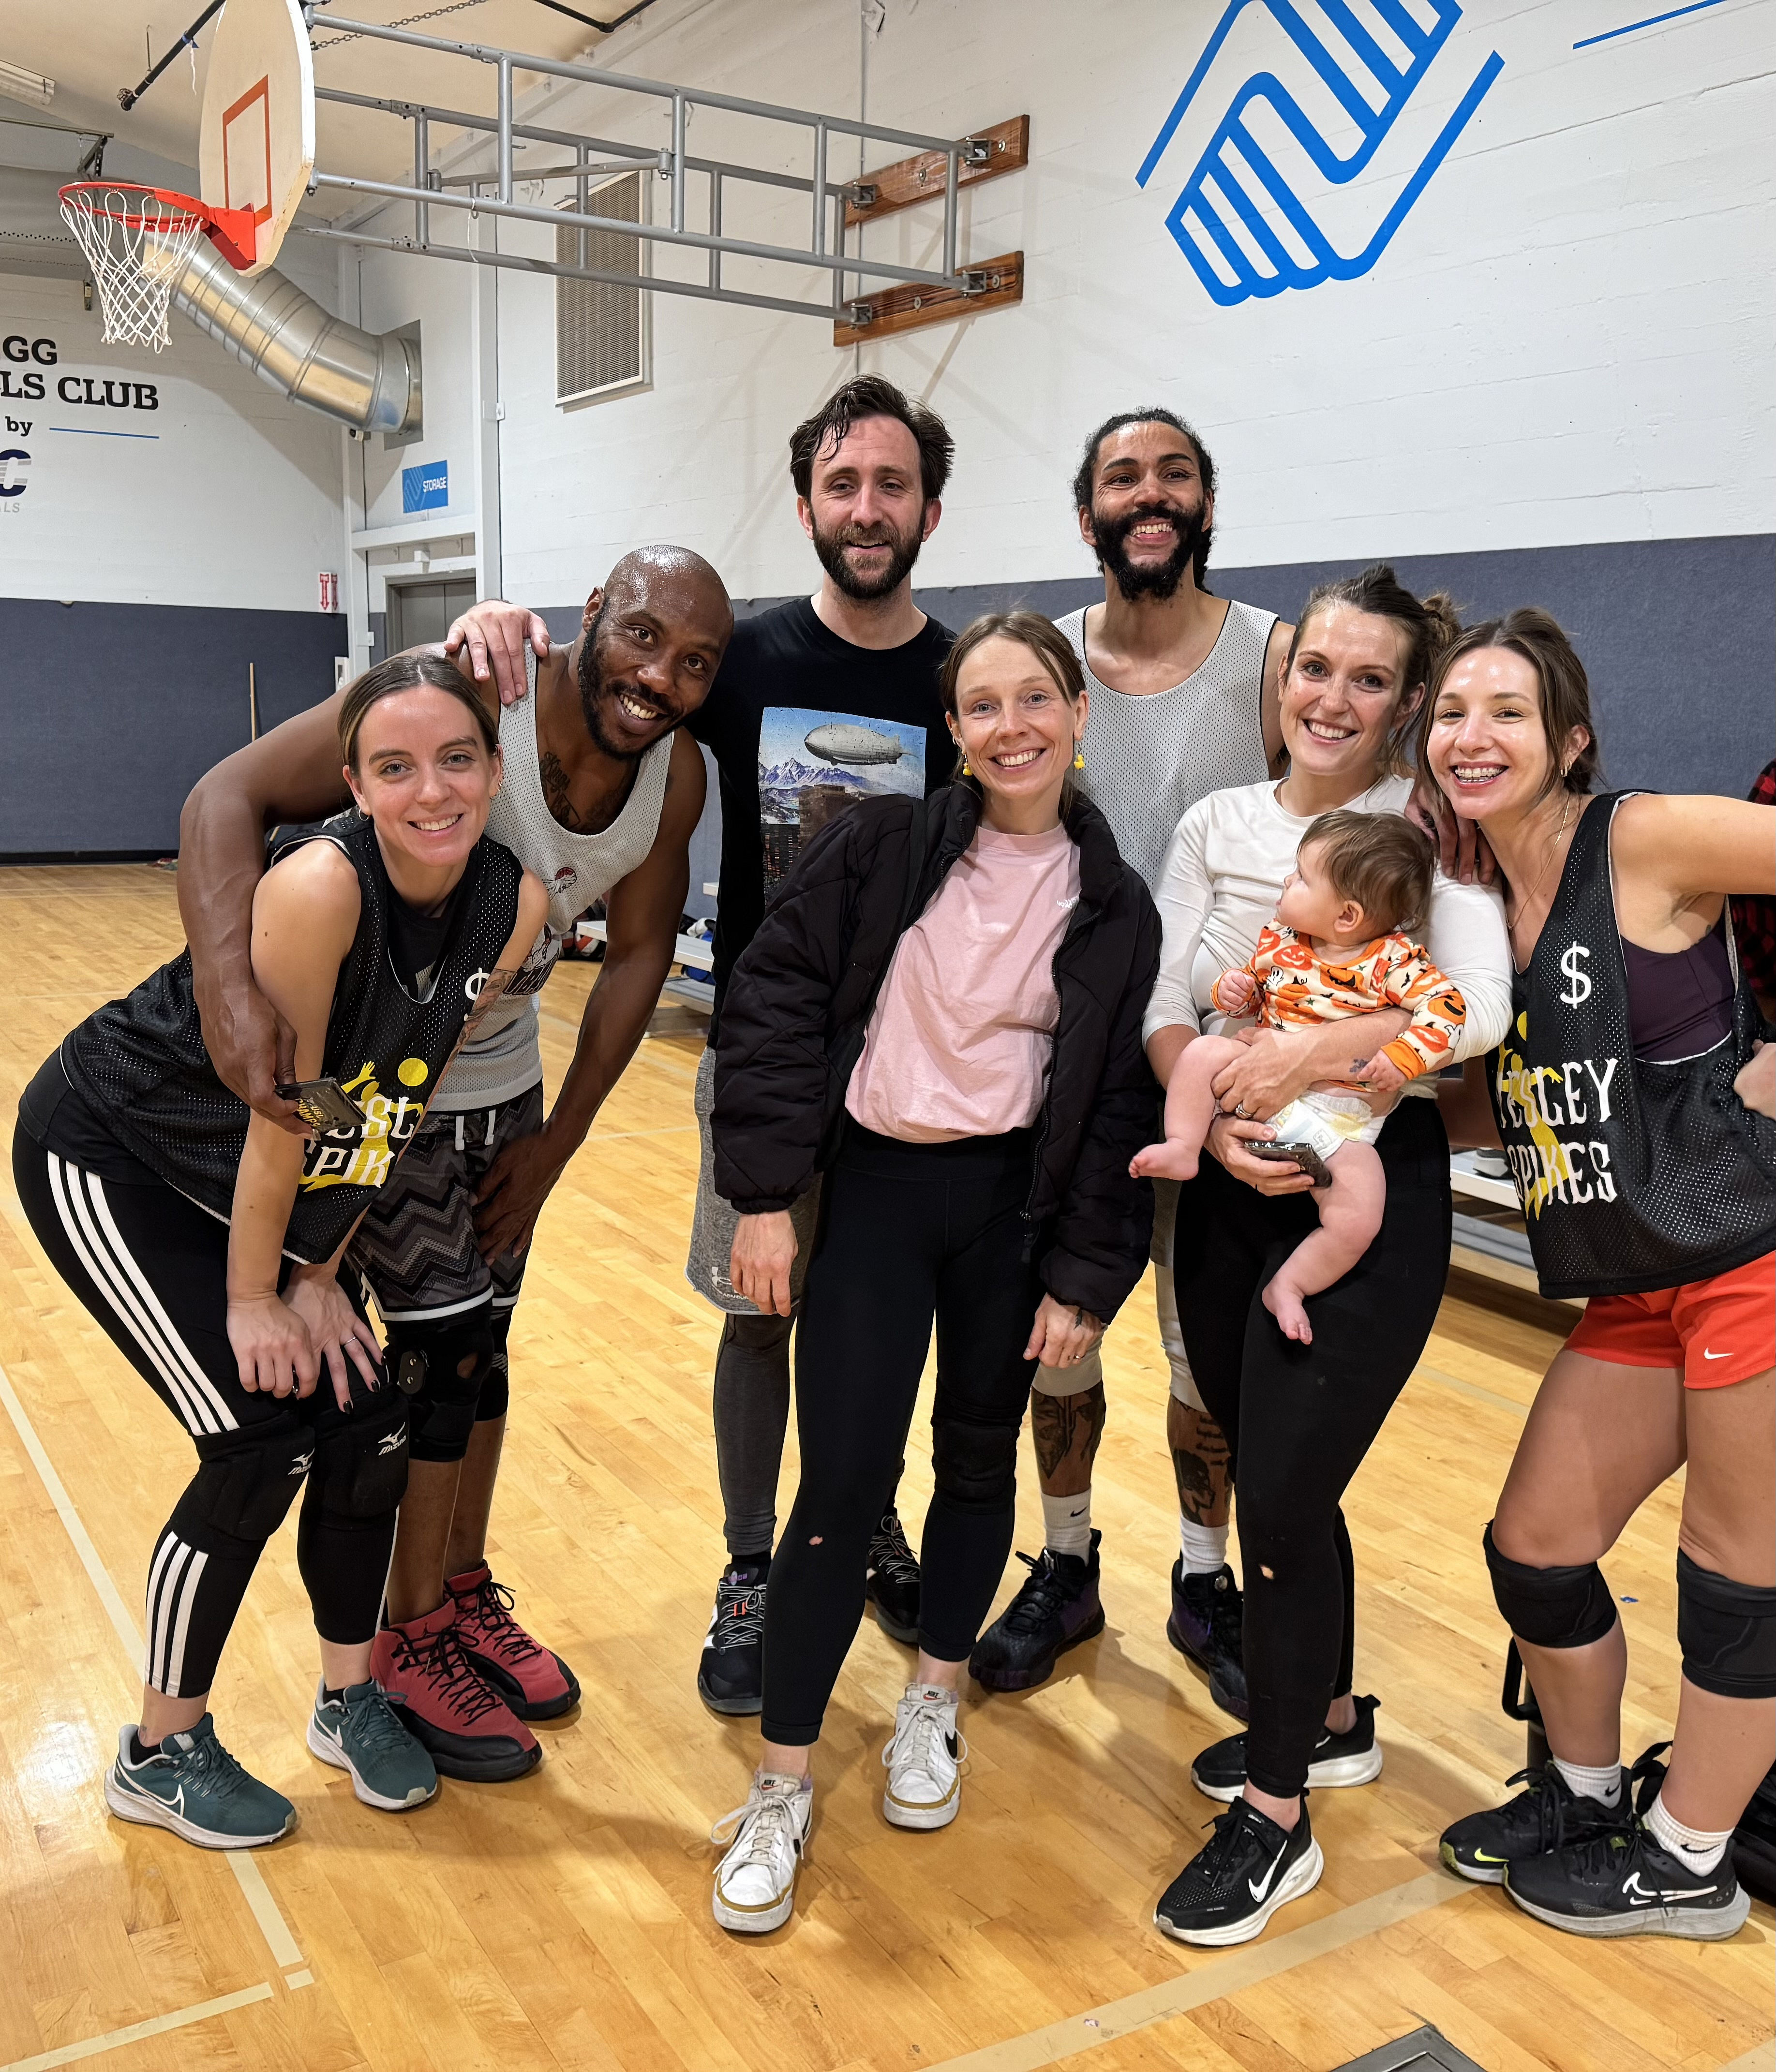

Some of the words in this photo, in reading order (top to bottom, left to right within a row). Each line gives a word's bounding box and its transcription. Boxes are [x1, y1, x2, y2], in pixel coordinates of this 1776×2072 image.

[2, 335, 58, 366] GG
[0, 370, 45, 400] LS
[58, 377, 159, 410] CLUB
[5, 416, 33, 437] by
[422, 476, 447, 493] STORAGE
[1560, 941, 1592, 1009] $
[1496, 1058, 1618, 1128] ESLEY
[311, 1106, 324, 1119] USL
[1507, 1141, 1618, 1205] SPIKES
